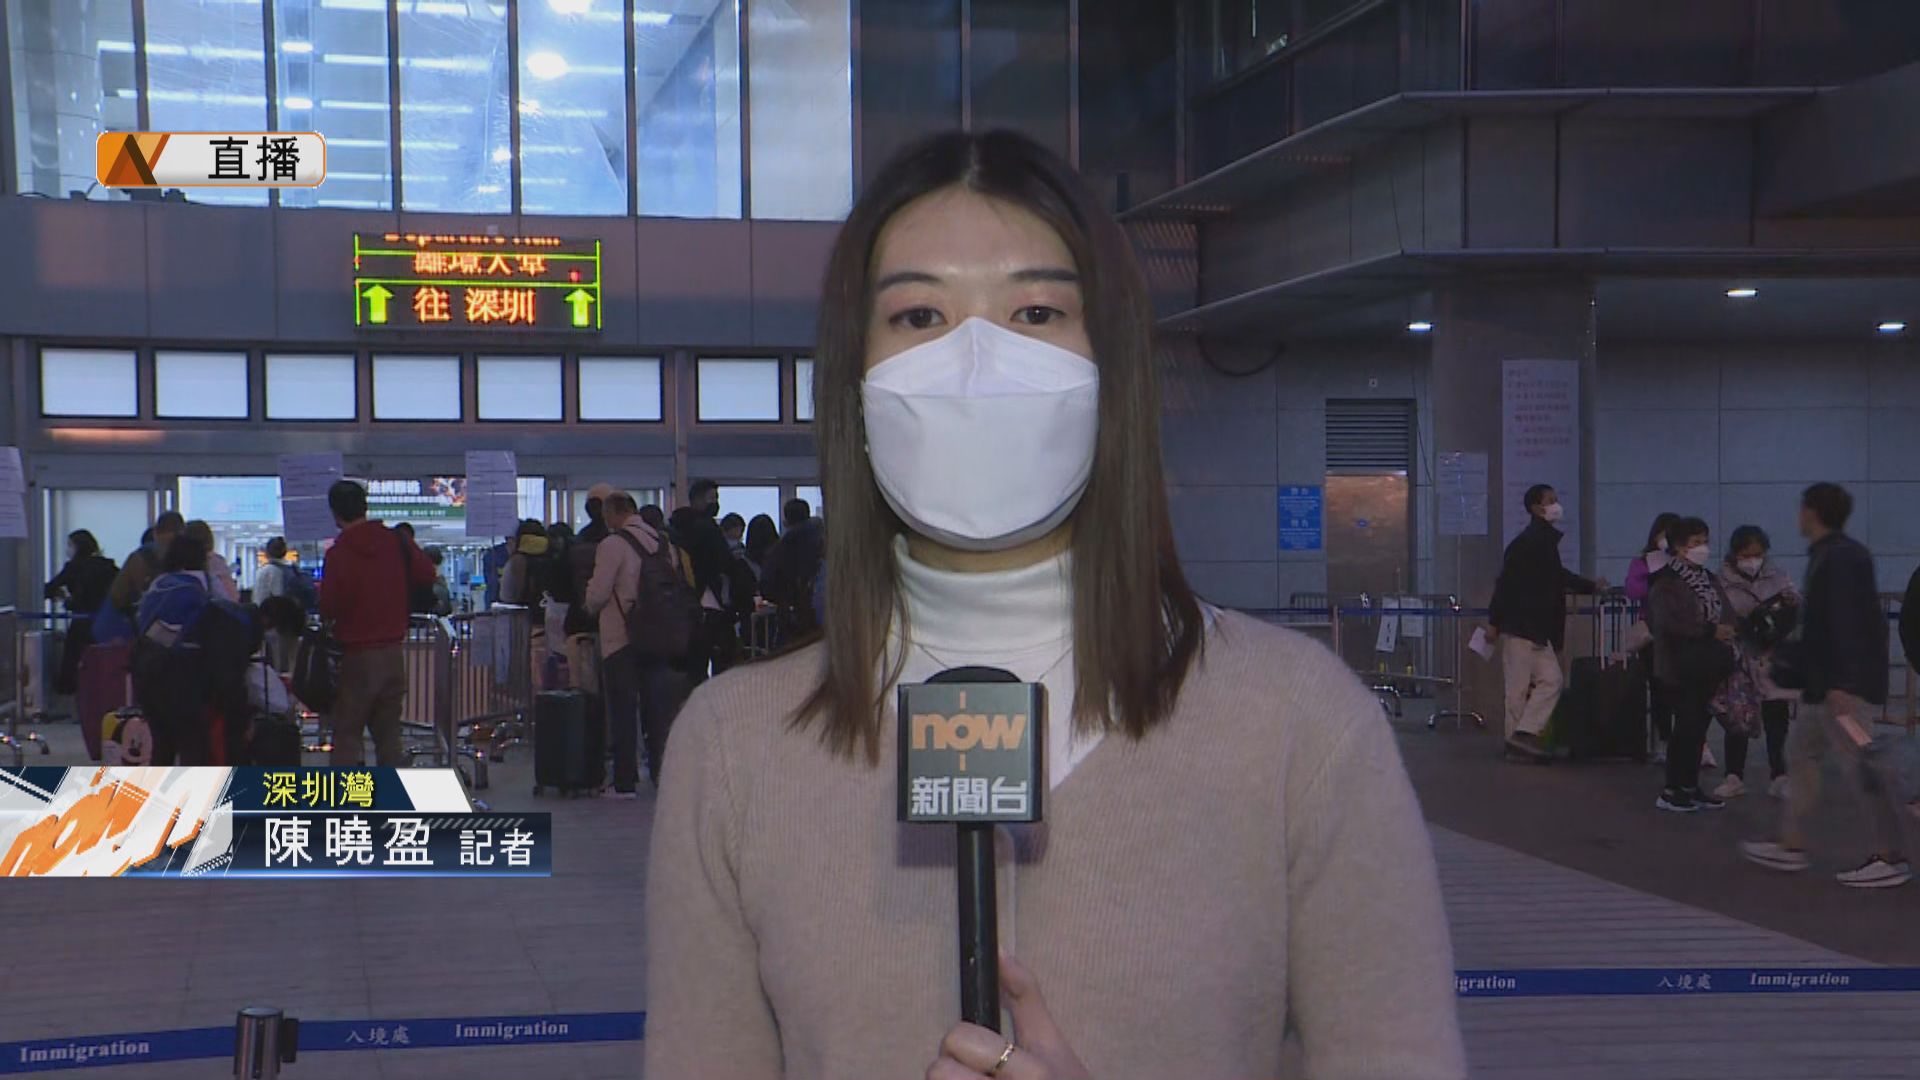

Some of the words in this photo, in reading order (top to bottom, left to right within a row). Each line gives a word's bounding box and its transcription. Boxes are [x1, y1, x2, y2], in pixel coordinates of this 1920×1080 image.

[414, 286, 451, 324] 往
[465, 287, 536, 325] 深圳
[912, 713, 1027, 751] now
[911, 776, 1027, 815] 新聞台
[1656, 974, 1712, 990] 入境處
[1750, 972, 1850, 988] Immigration
[345, 1024, 411, 1046] 入境處
[456, 1020, 569, 1040] Immigration
[20, 1040, 150, 1062] Immigration
